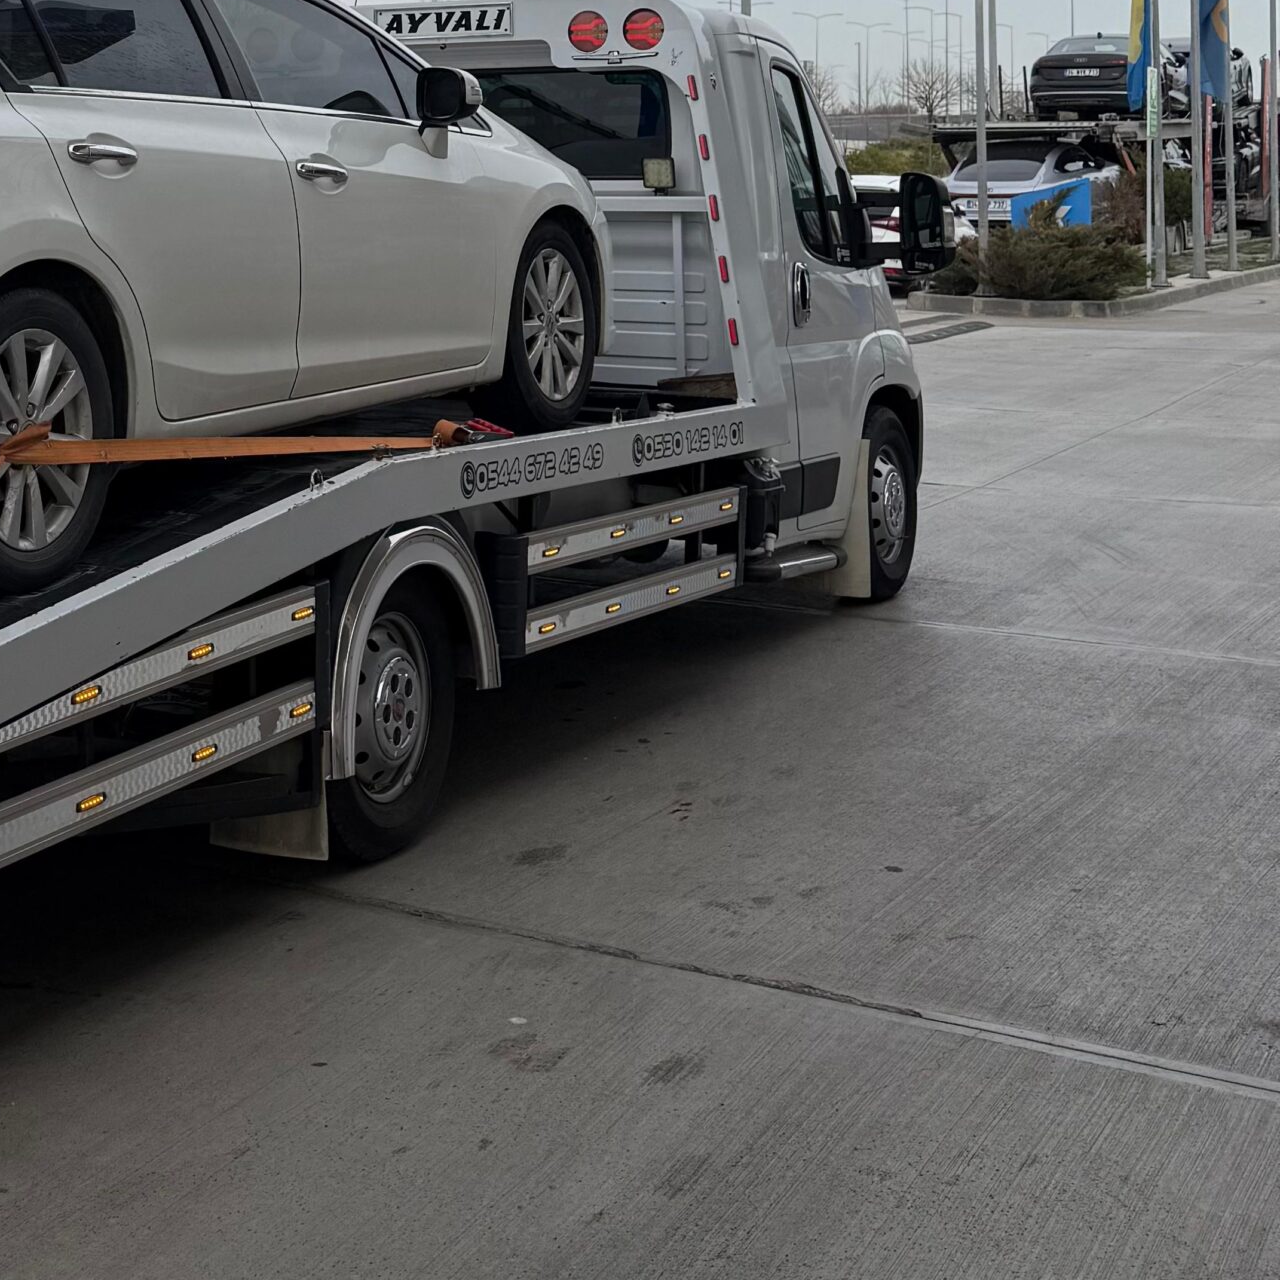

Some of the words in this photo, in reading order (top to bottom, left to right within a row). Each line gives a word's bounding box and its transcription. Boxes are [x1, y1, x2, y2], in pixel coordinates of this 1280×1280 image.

[385, 8, 506, 34] AYVALI
[644, 431, 684, 461] 0530
[686, 427, 711, 454] 142
[712, 424, 728, 449] 14
[729, 421, 744, 446] 01
[476, 456, 522, 492] 0544
[524, 451, 556, 482] 672
[559, 446, 581, 475] 42
[583, 442, 604, 470] 49
